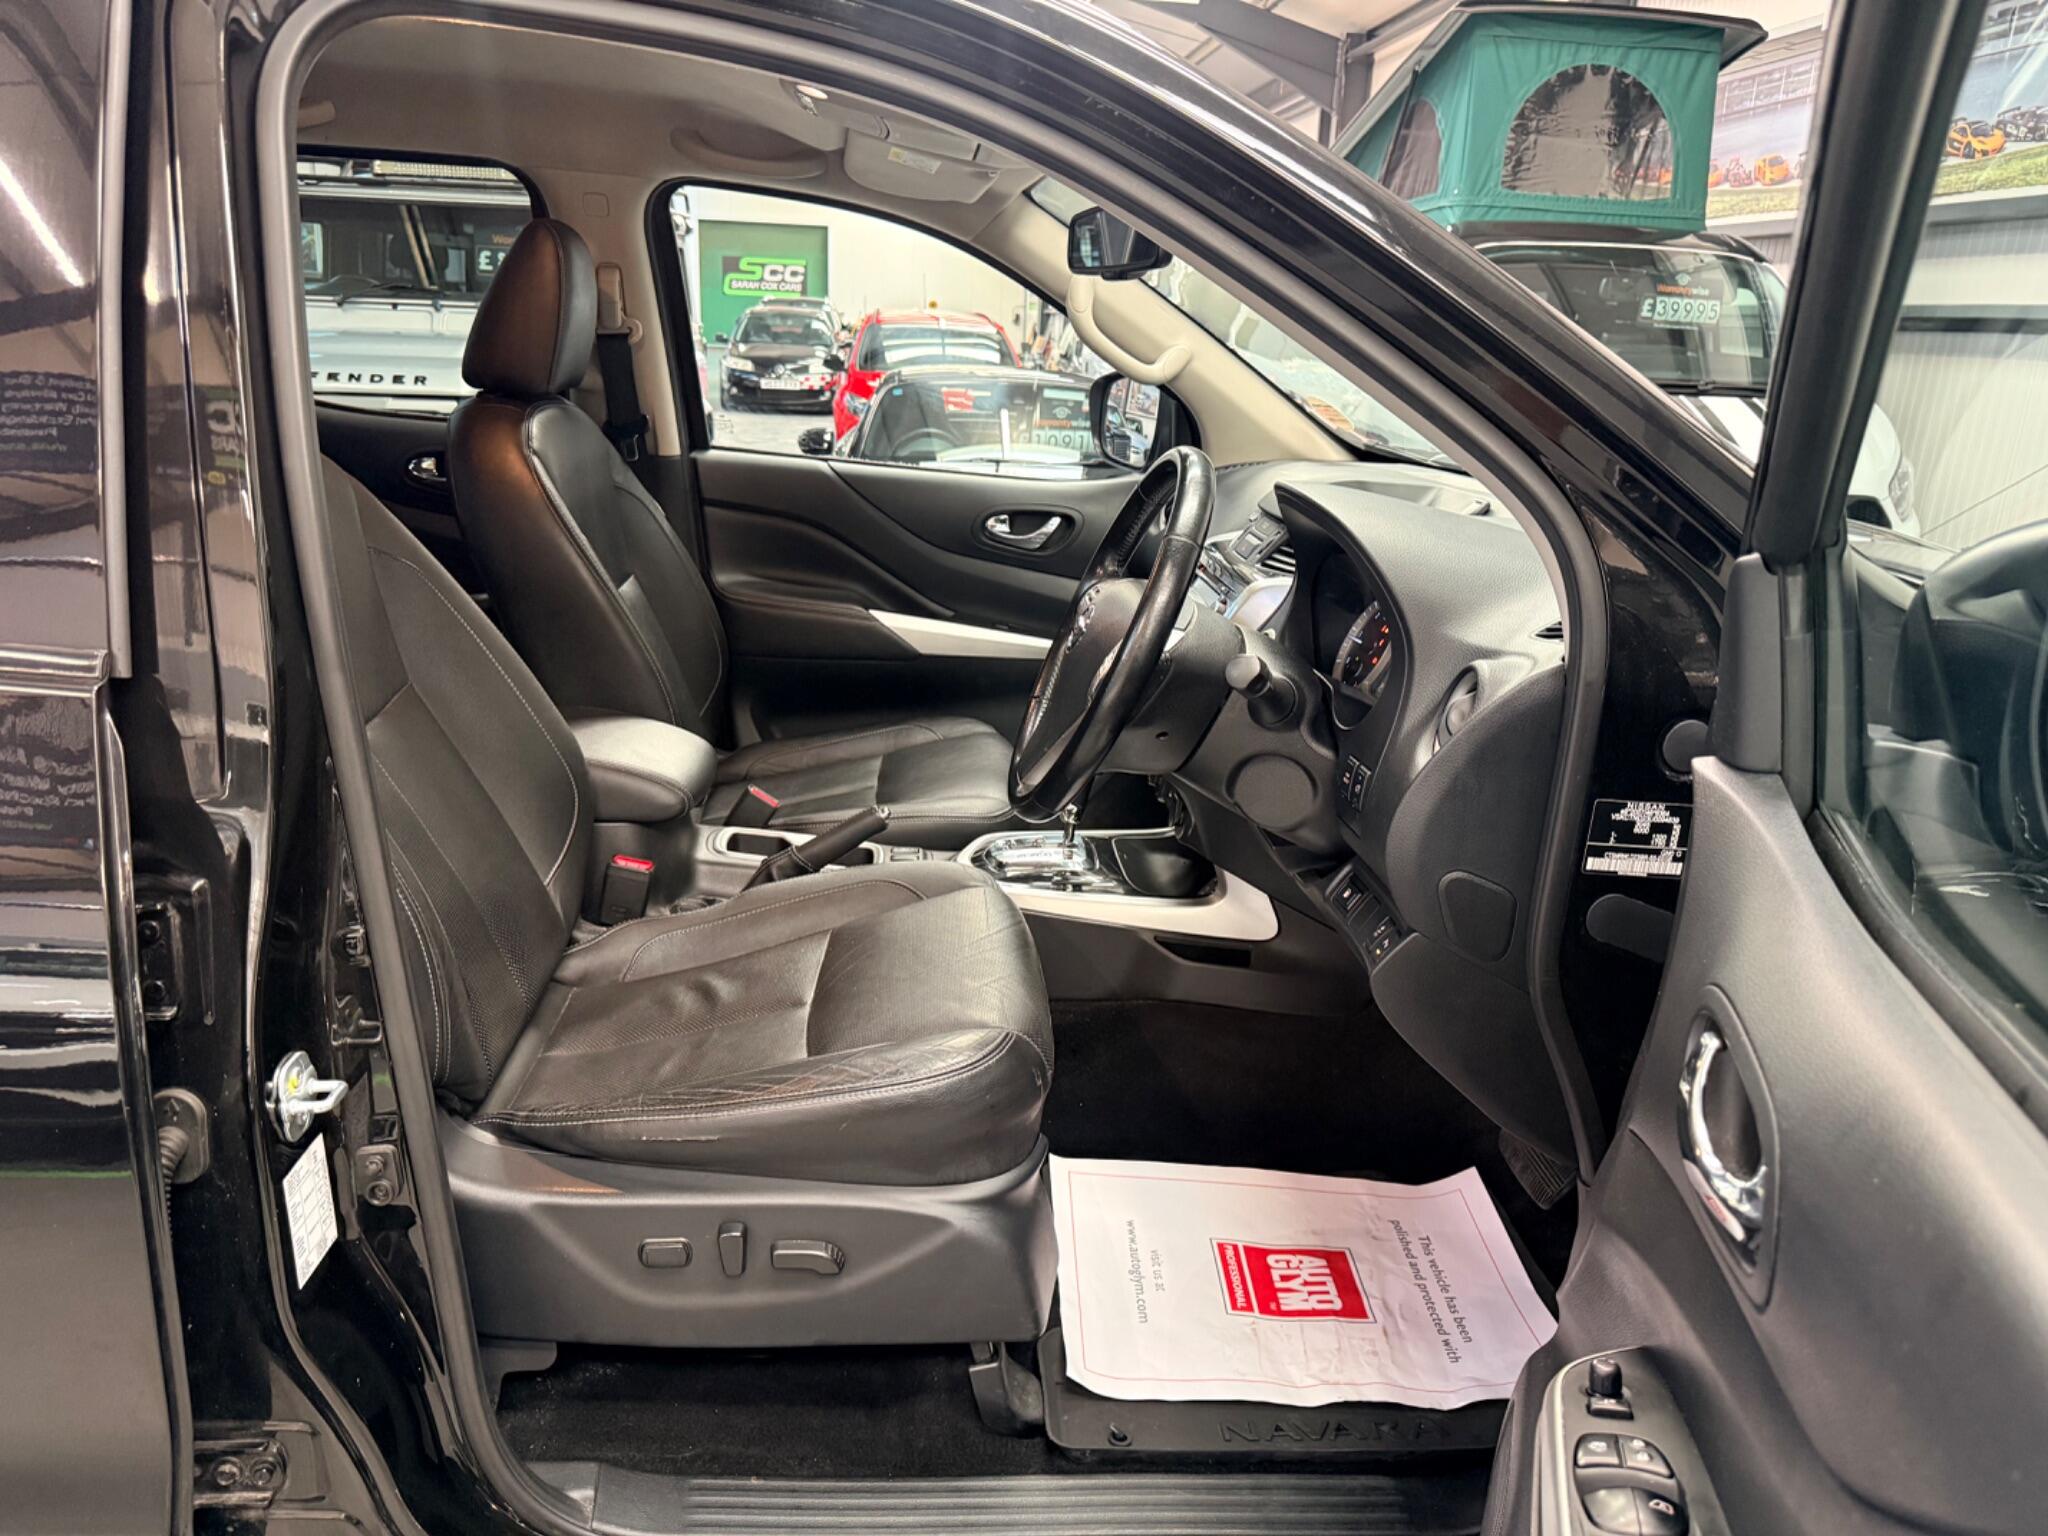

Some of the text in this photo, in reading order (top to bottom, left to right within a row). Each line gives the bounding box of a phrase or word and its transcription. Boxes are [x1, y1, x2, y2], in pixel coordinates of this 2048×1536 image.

[724, 257, 806, 284] SCC
[1126, 1220, 1148, 1324] www.autoglym.com
[1223, 1244, 1247, 1308] PROFESSIONAL
[1266, 1254, 1312, 1311] GLYM
[1297, 1254, 1343, 1310] AUTO
[1387, 1219, 1460, 1363] polished and protected with
[1418, 1234, 1472, 1343] This vehicle has been
